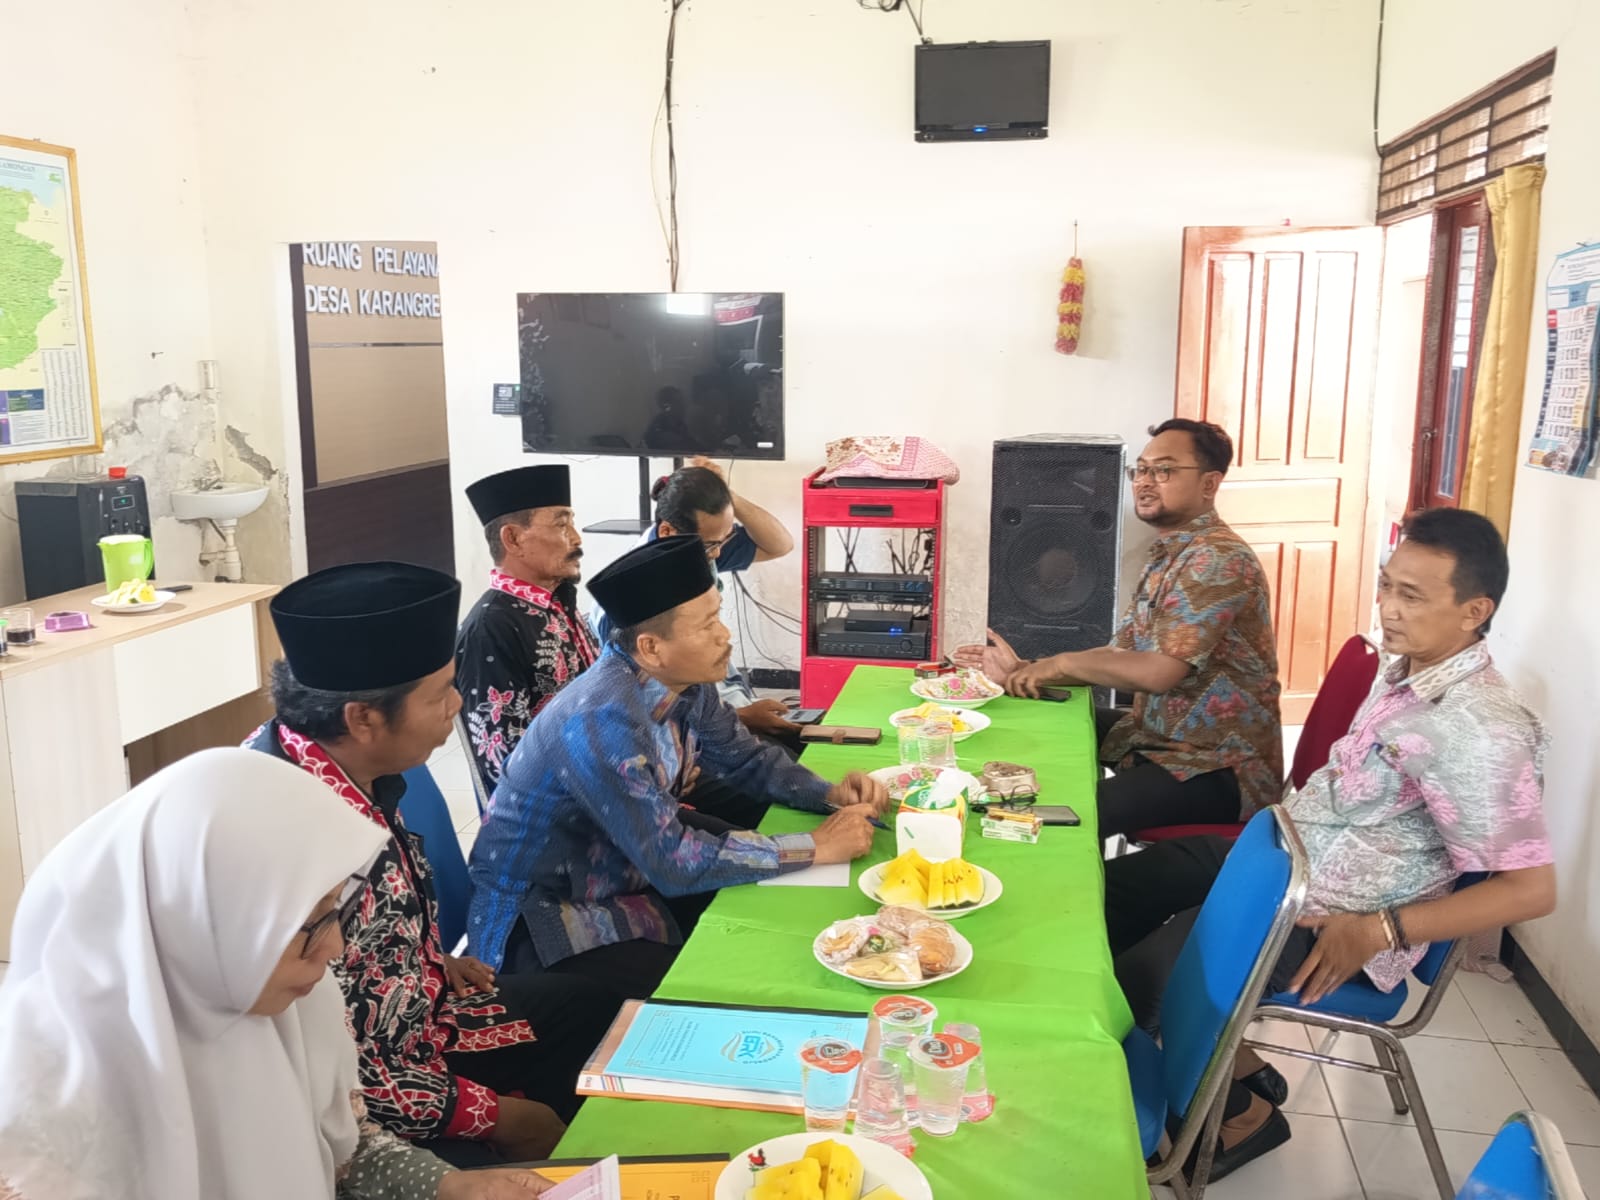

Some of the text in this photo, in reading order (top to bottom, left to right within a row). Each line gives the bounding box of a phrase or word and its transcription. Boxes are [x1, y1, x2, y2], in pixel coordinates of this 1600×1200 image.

[302, 242, 362, 270] RUANG
[304, 285, 440, 317] DESA KARANGRE
